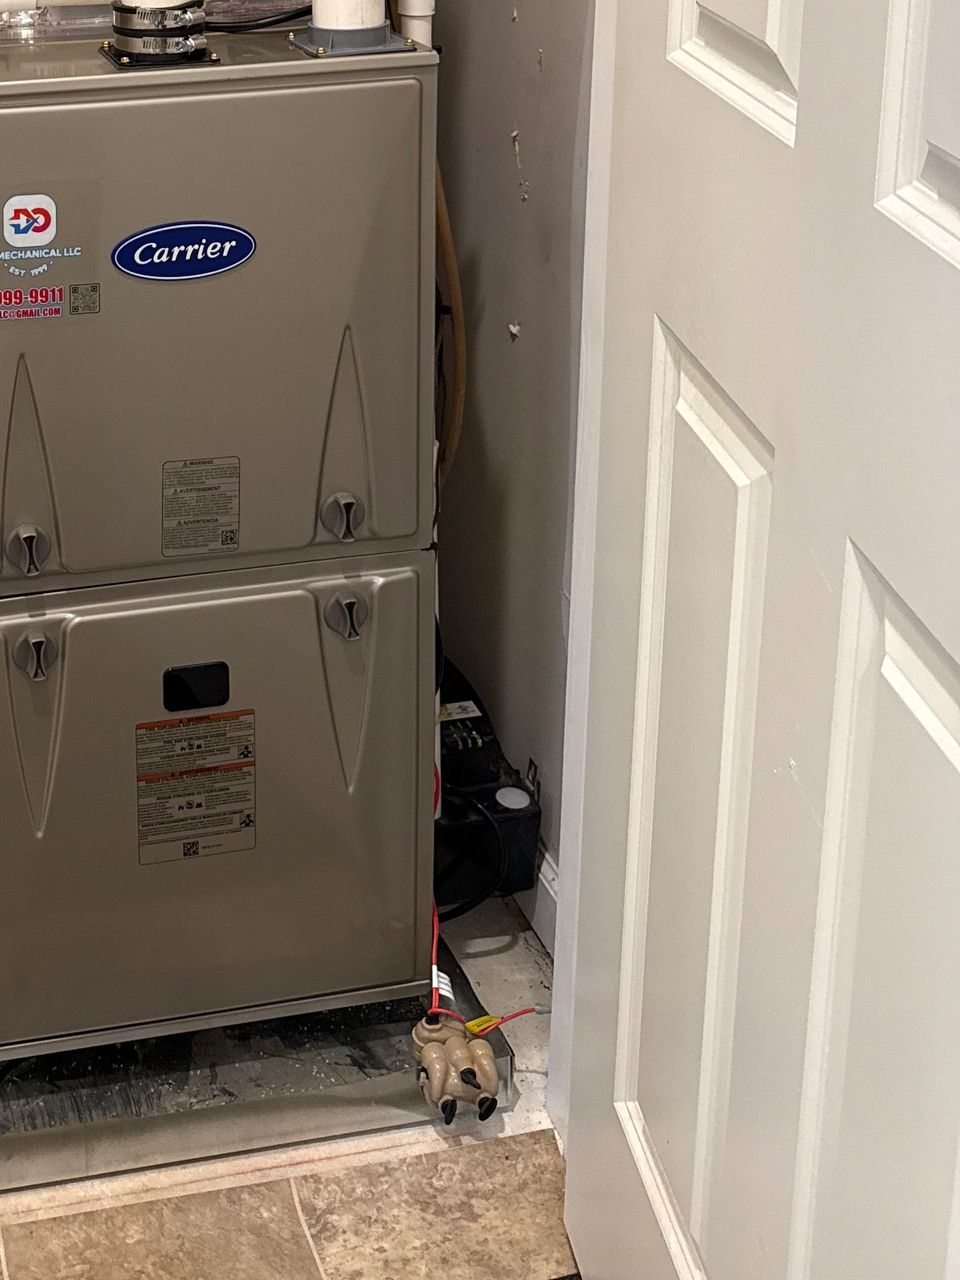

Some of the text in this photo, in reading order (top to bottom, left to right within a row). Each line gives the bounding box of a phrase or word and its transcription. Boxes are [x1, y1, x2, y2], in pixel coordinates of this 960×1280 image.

[63, 247, 81, 258] LLC
[133, 238, 236, 265] Carrier
[9, 264, 48, 277] EST 1999
